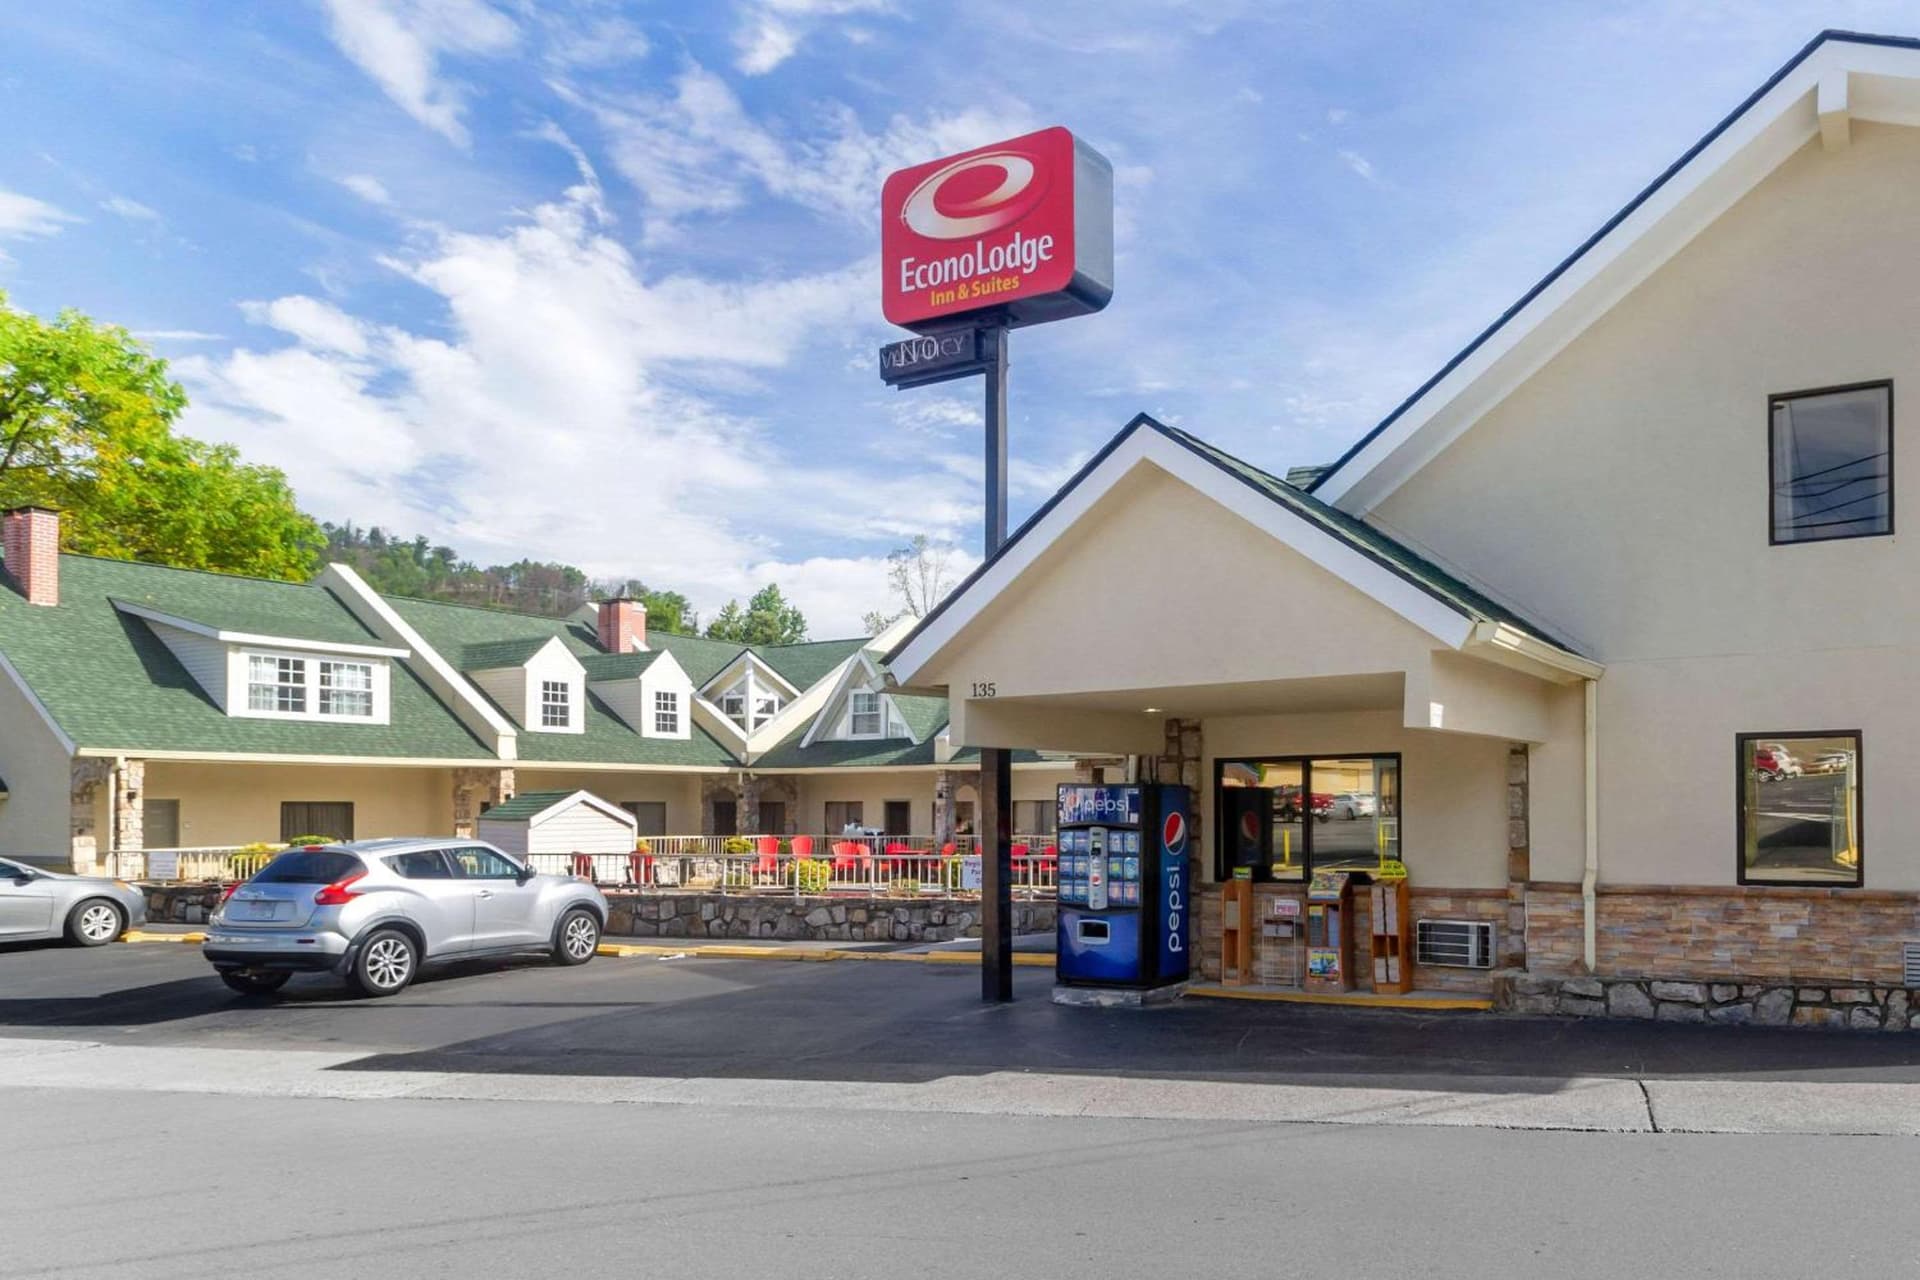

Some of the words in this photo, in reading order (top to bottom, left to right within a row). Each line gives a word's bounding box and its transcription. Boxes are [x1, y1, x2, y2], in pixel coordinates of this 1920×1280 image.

[930, 290, 955, 306] Inn
[957, 283, 969, 299] &
[971, 275, 1019, 298] Suites
[895, 336, 937, 367] NO
[971, 682, 996, 697] 135
[1166, 864, 1183, 953] pepsi
